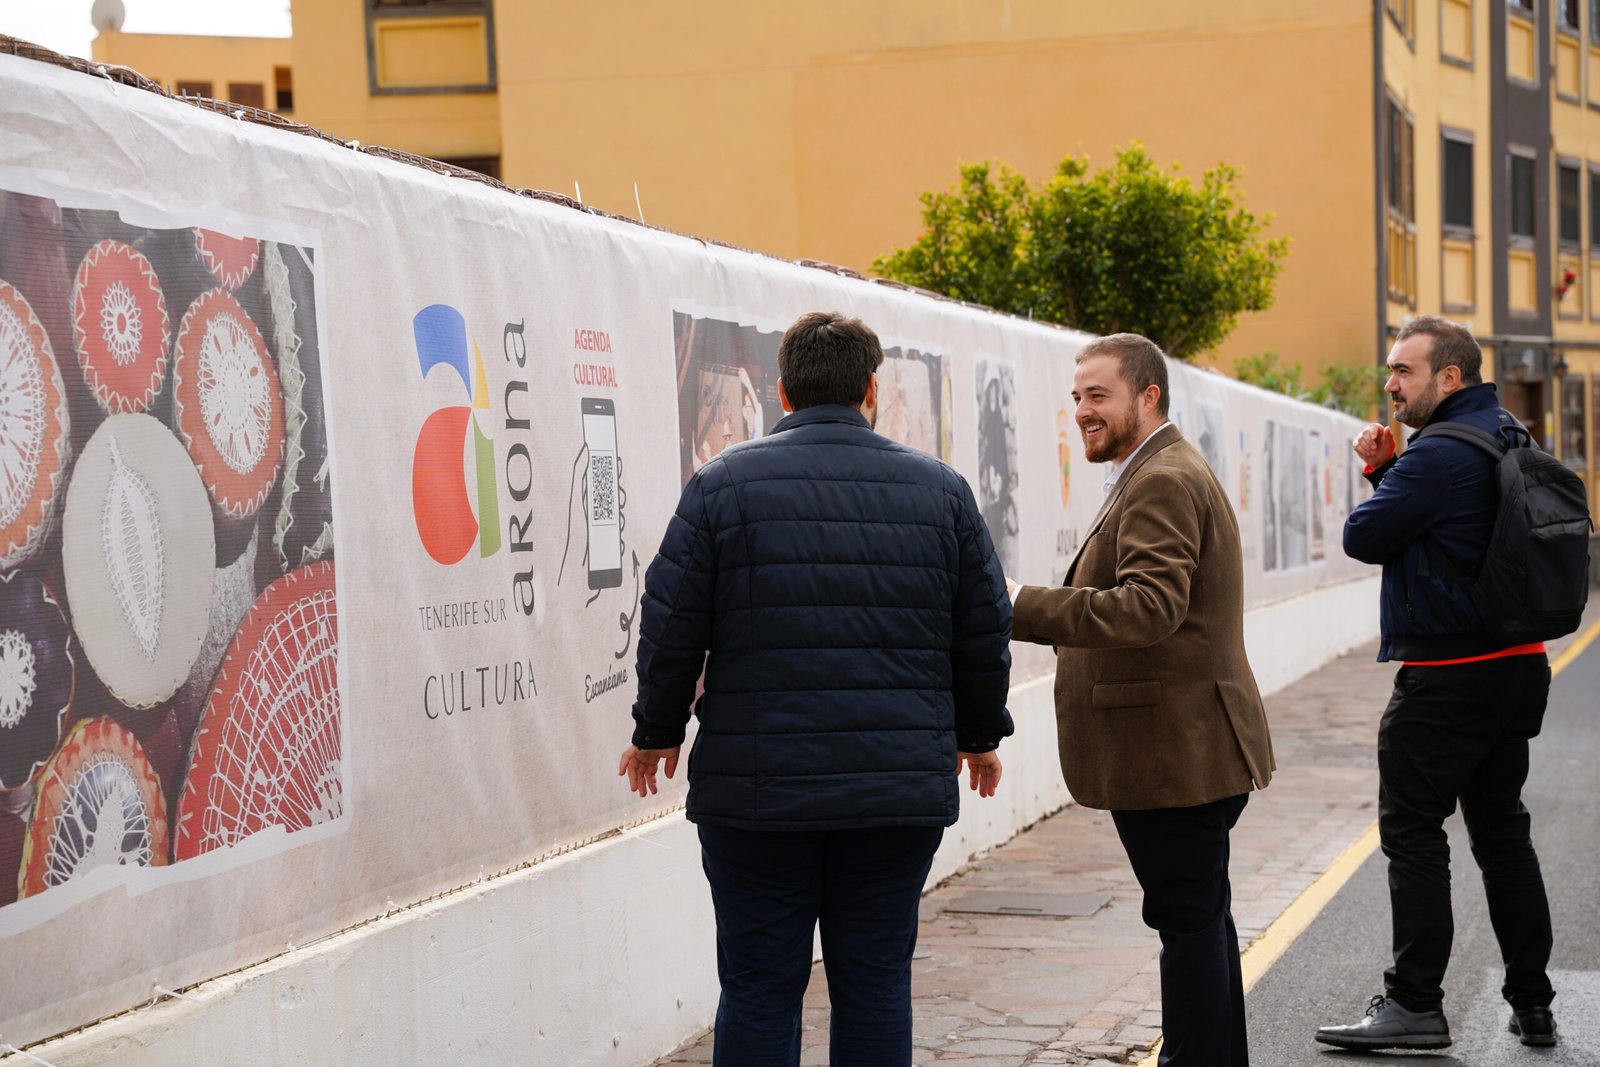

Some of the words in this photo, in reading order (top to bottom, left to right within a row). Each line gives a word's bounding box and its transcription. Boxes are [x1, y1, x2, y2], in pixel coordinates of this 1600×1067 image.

[574, 328, 612, 353] AGENDA
[573, 363, 618, 388] CULTURAL
[418, 601, 479, 631] TENERIFE
[483, 598, 507, 623] SUR
[424, 657, 538, 720] CULTURA
[584, 663, 629, 704] Escanéame
